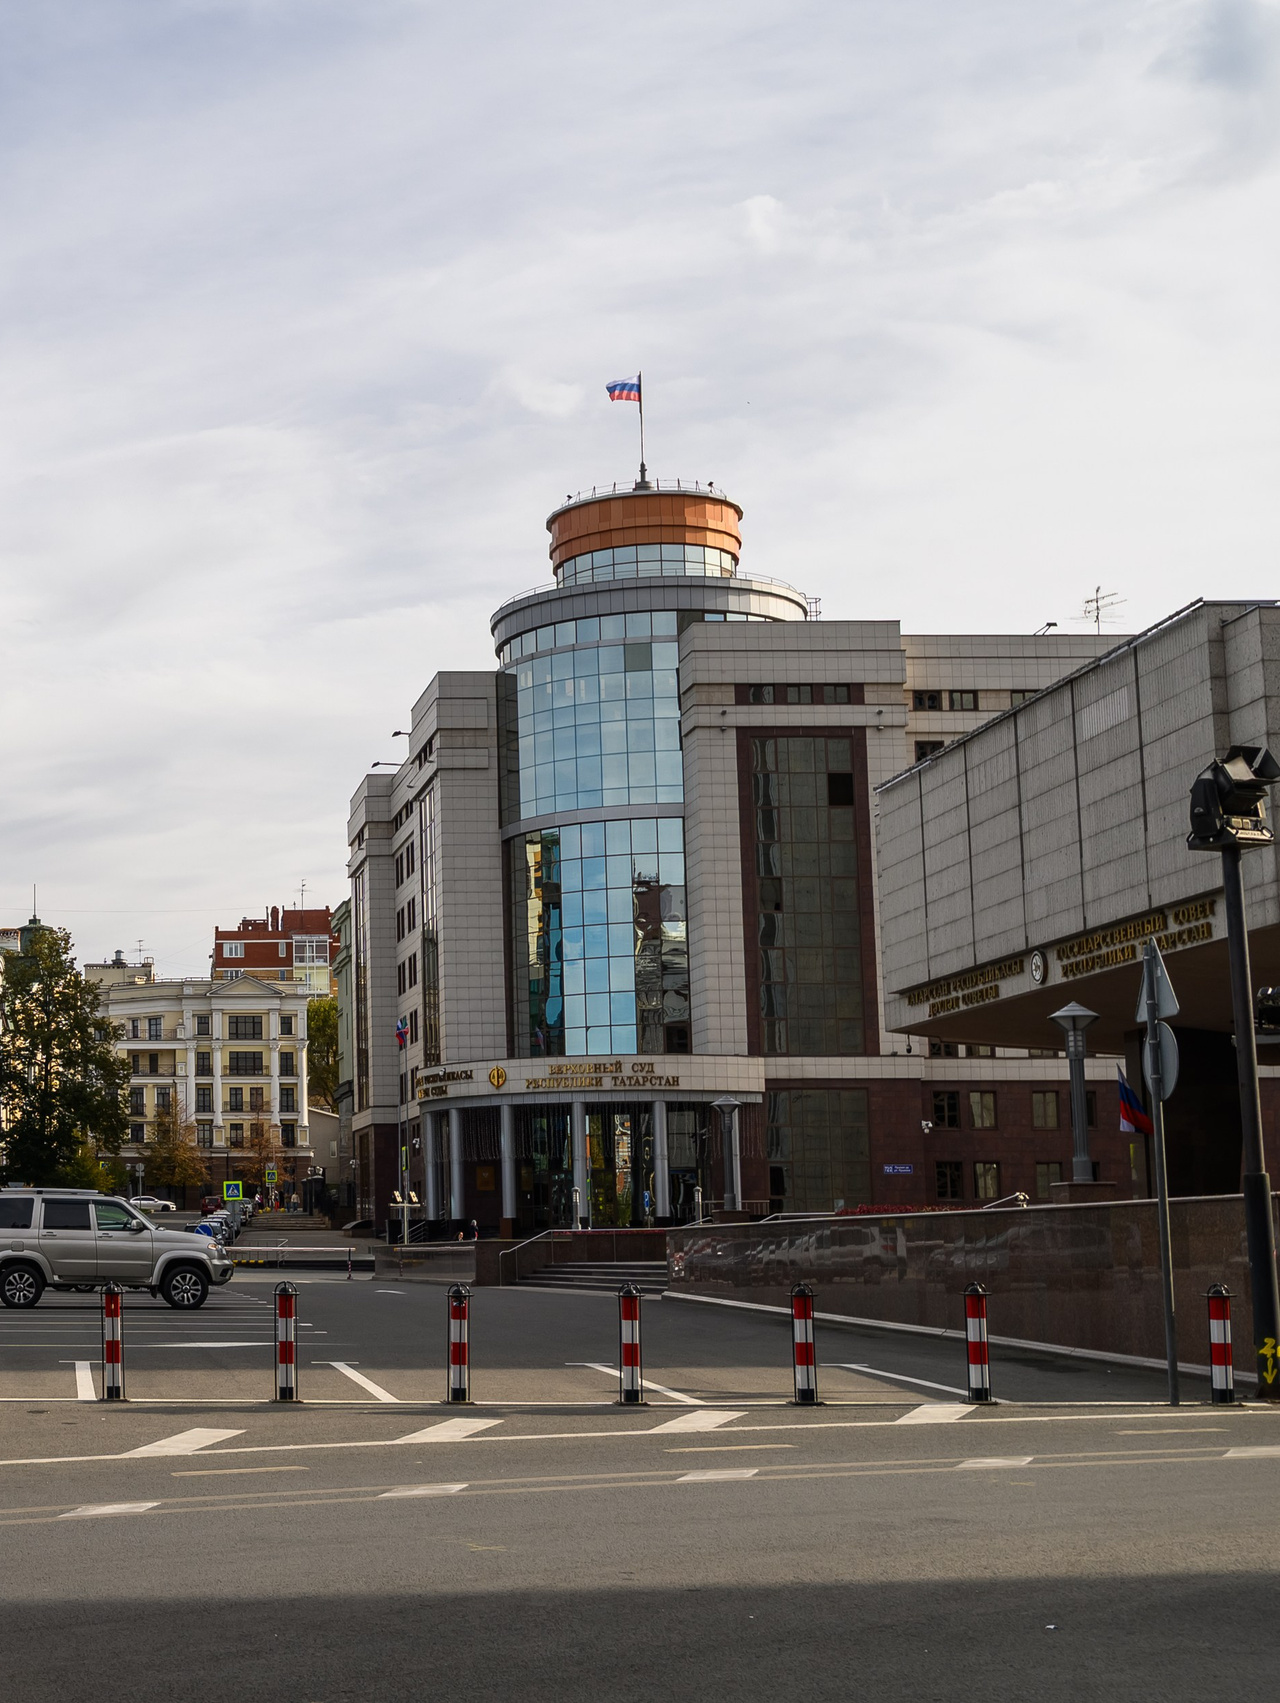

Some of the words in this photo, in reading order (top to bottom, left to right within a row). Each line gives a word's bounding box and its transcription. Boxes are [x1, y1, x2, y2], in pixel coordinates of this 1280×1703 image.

[1057, 909, 1167, 960] ГОСУДАРСТВЕННЫЙ
[1172, 900, 1215, 925] СОВЕТ
[1061, 944, 1136, 978] РЕСПУБЛИКИ
[1139, 922, 1211, 956] ТАРСТАН
[951, 959, 1024, 992] РЕСПУБЛИКАСЫ
[525, 1076, 603, 1089] РЕСПУБЛИКИ
[612, 1076, 680, 1087] ТАТАРСТАН
[548, 1060, 623, 1075] ВЕРХОВНЫЙ
[631, 1063, 655, 1074] СУД
